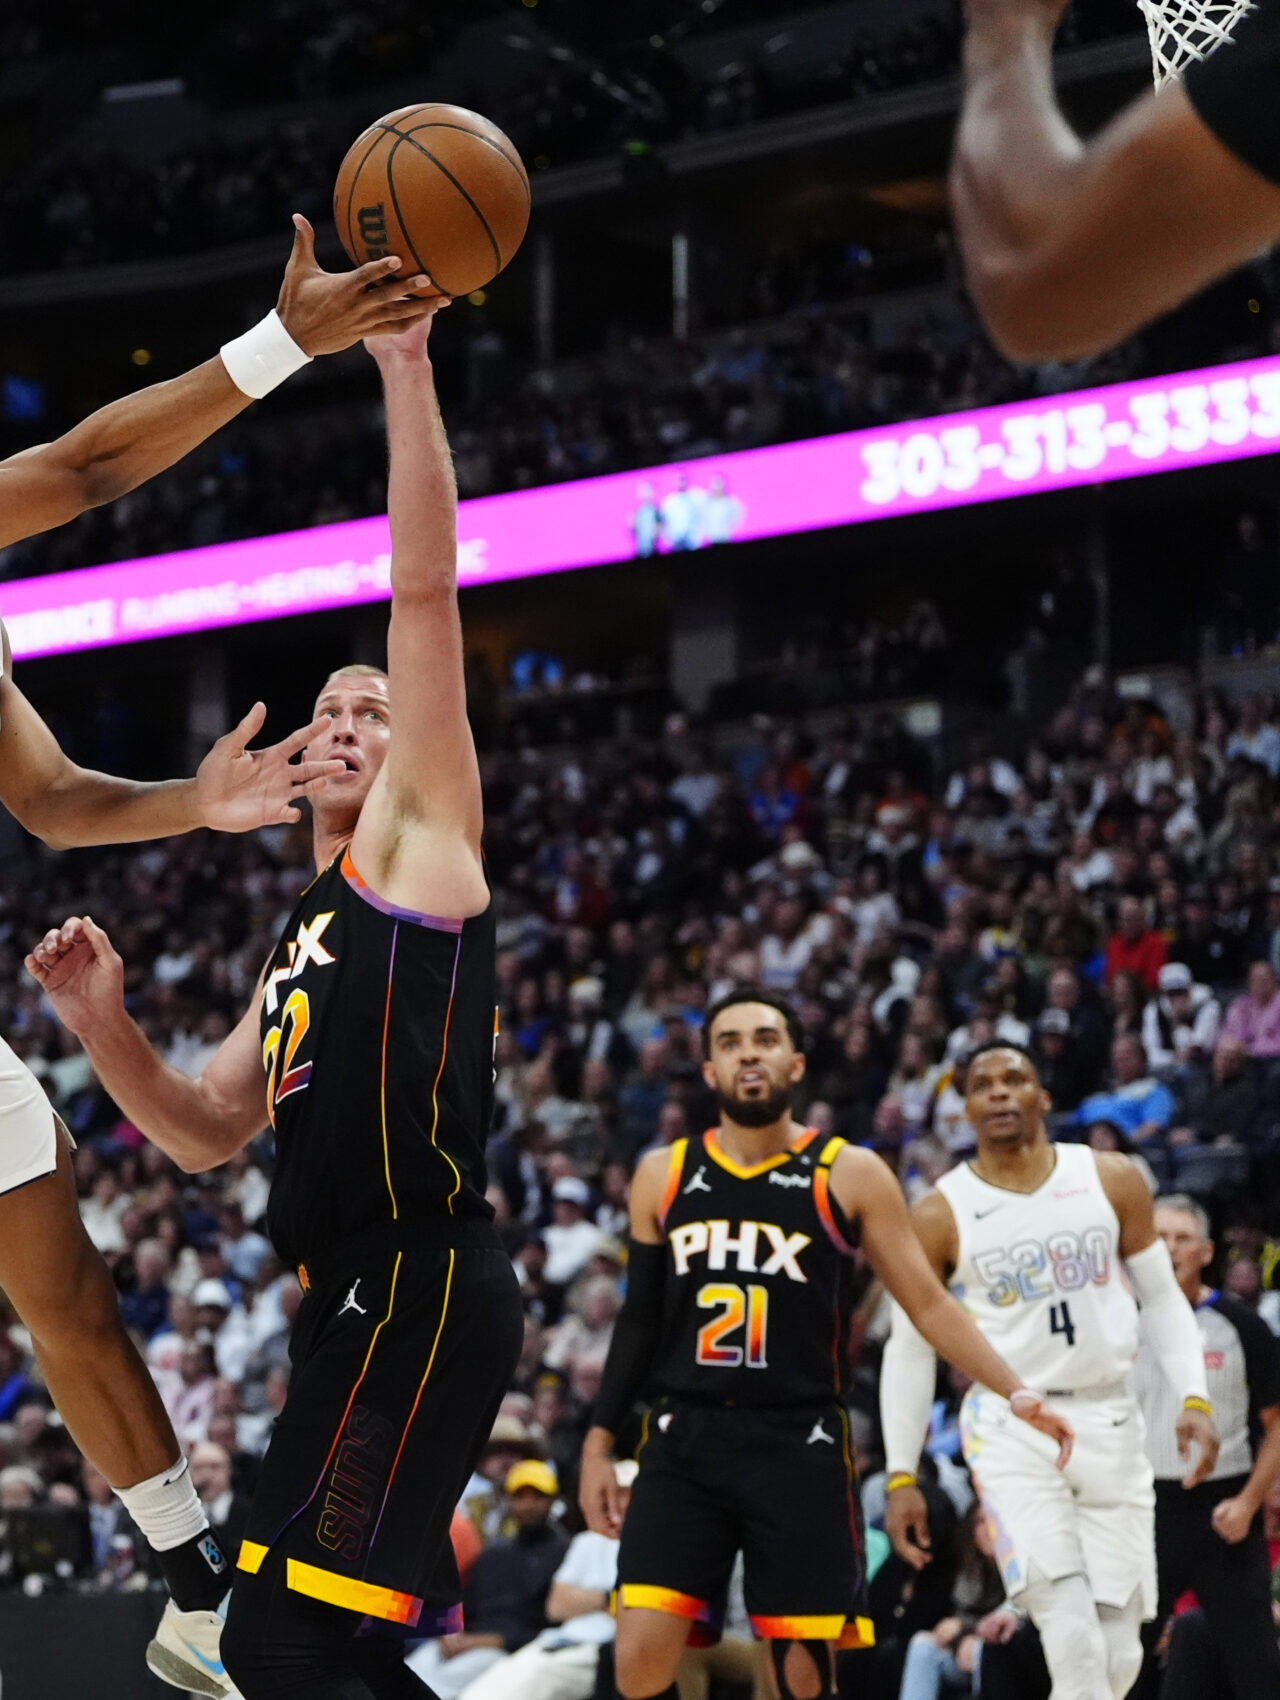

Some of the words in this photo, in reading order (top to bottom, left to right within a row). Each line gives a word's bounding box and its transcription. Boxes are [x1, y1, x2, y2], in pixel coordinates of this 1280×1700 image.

[860, 371, 1280, 504] 303-313-3333
[669, 1219, 812, 1284] PHX
[971, 1225, 1112, 1307] 5280
[695, 1283, 768, 1369] 21
[1050, 1301, 1075, 1346] 4
